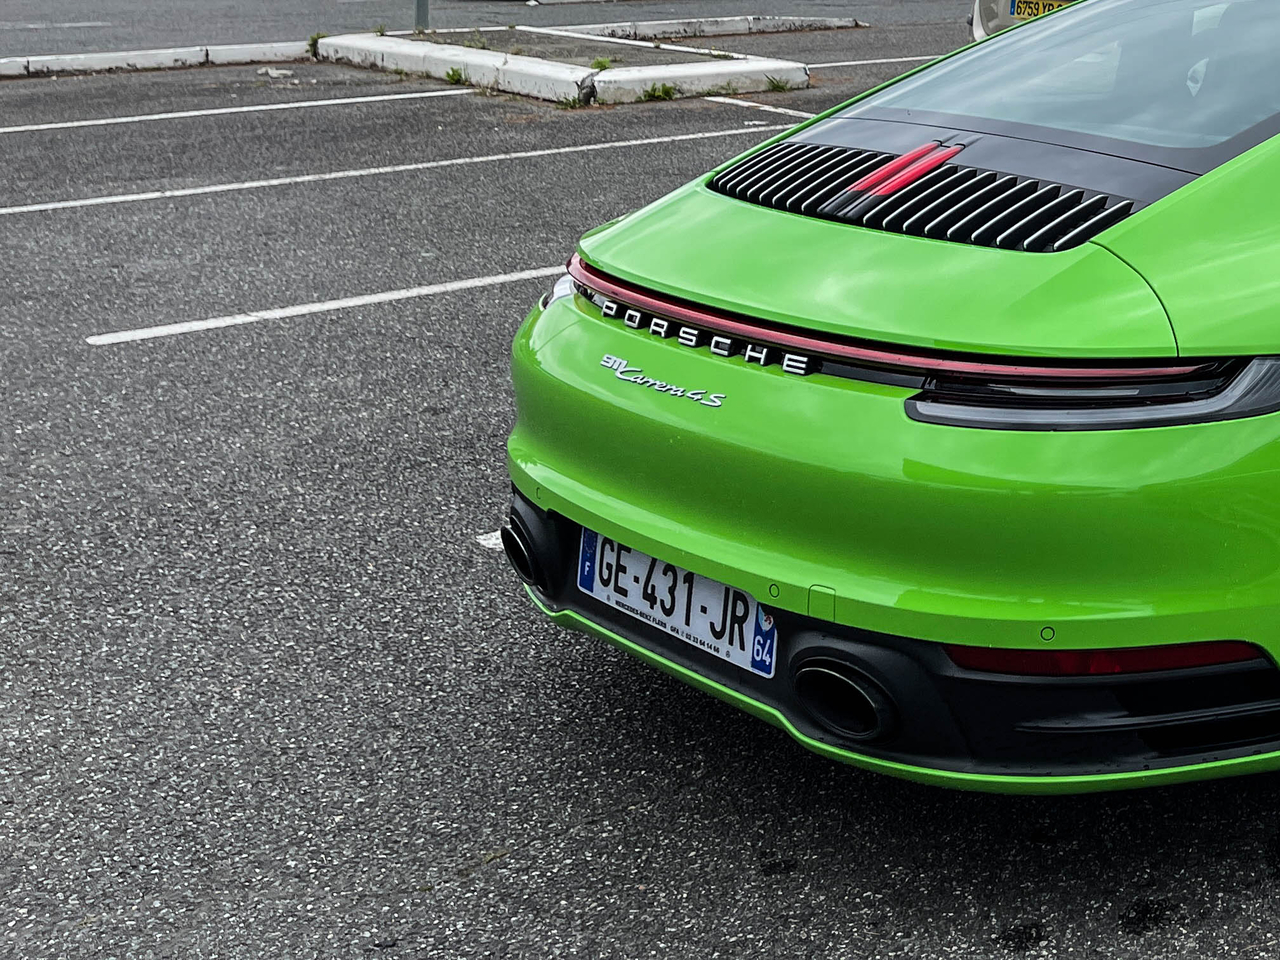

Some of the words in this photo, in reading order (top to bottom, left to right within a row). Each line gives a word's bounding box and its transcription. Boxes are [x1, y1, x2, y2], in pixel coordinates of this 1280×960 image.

[1016, 0, 1040, 16] 6759
[601, 300, 809, 375] PORSCHE
[615, 368, 686, 397] Carrera
[584, 560, 591, 576] F
[598, 535, 750, 652] GE-431-JR
[753, 634, 772, 666] 64
